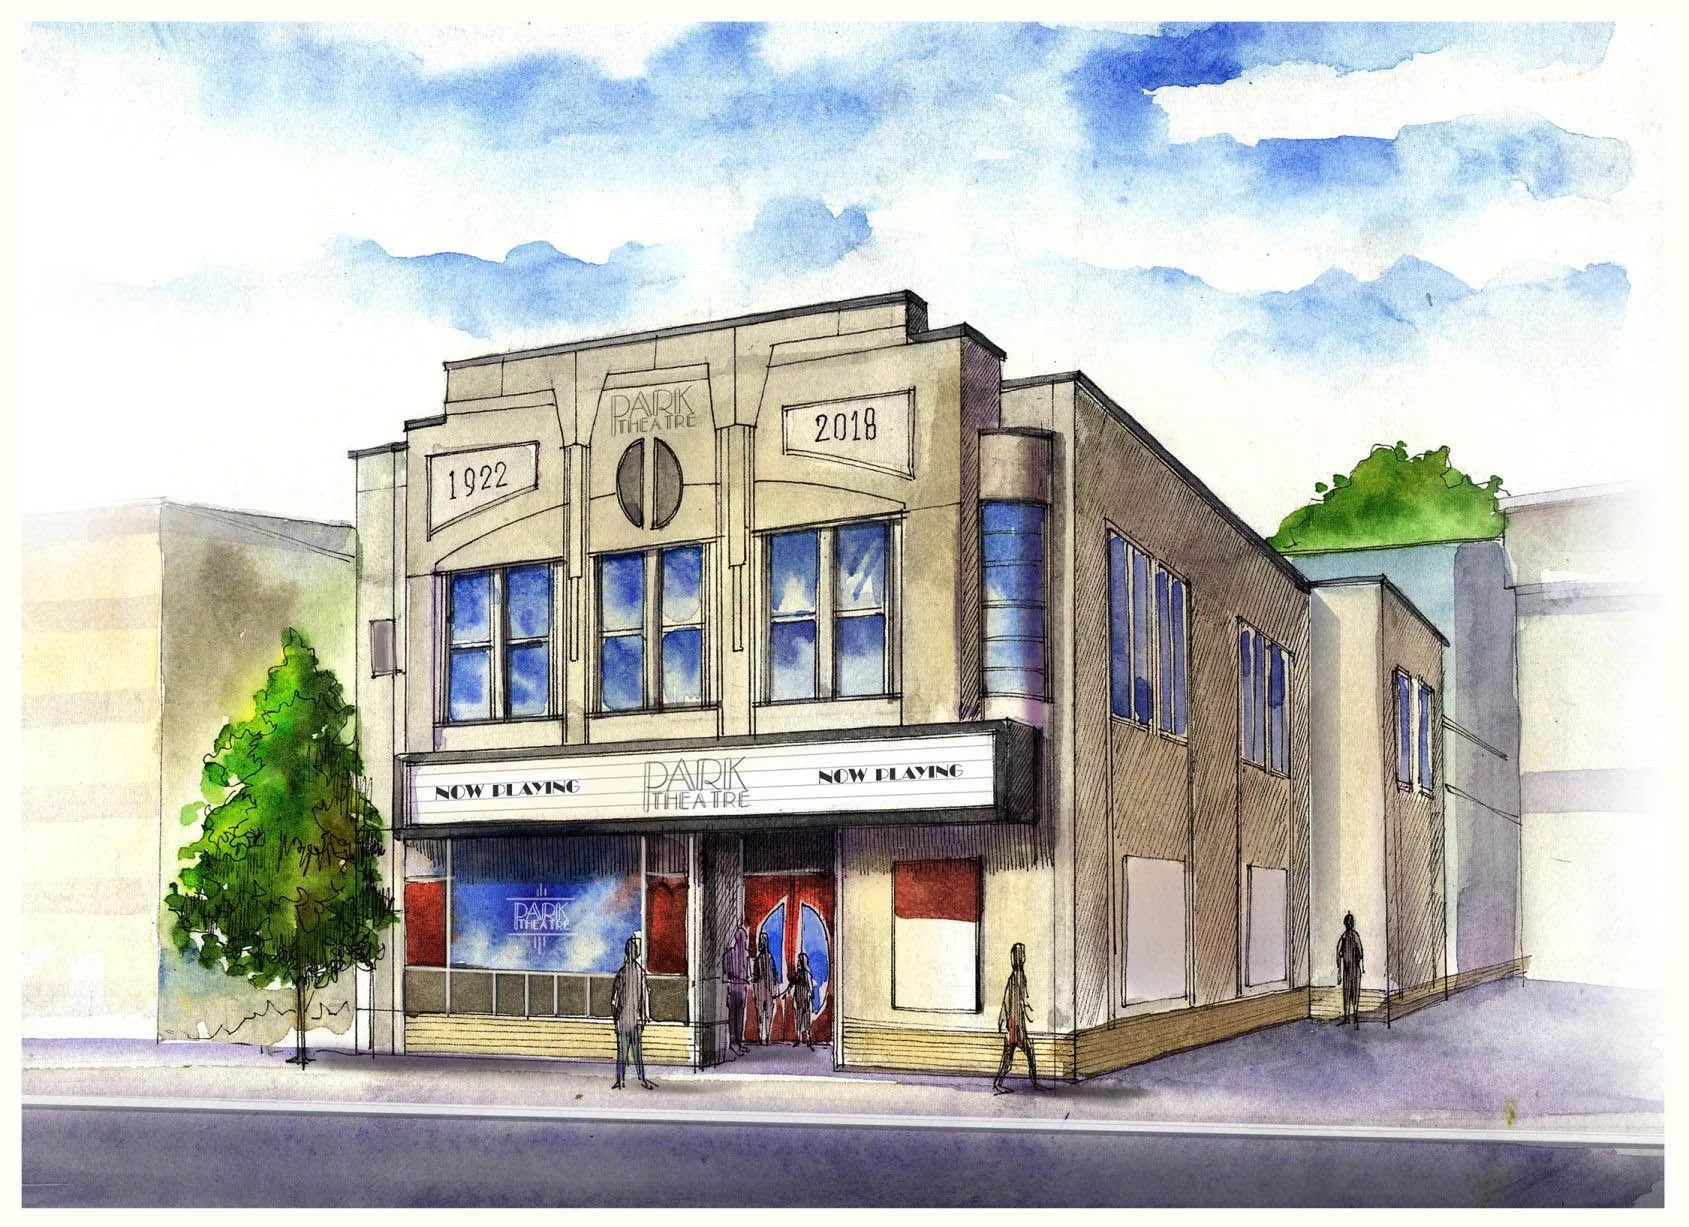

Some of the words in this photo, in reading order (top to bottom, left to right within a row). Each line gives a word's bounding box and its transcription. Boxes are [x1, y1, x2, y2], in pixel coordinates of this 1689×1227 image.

[611, 386, 693, 436] PARK
[618, 413, 697, 434] THEATRE
[815, 407, 877, 442] 2018
[449, 461, 508, 500] 1922
[643, 757, 750, 812] PARK
[818, 768, 868, 784] NOW
[875, 763, 964, 781] PLAYING
[435, 784, 485, 800] NOW
[492, 779, 581, 798] PLAYING
[651, 790, 750, 811] THEATRE
[514, 902, 568, 931] PARK
[518, 918, 571, 931] THEATRE
